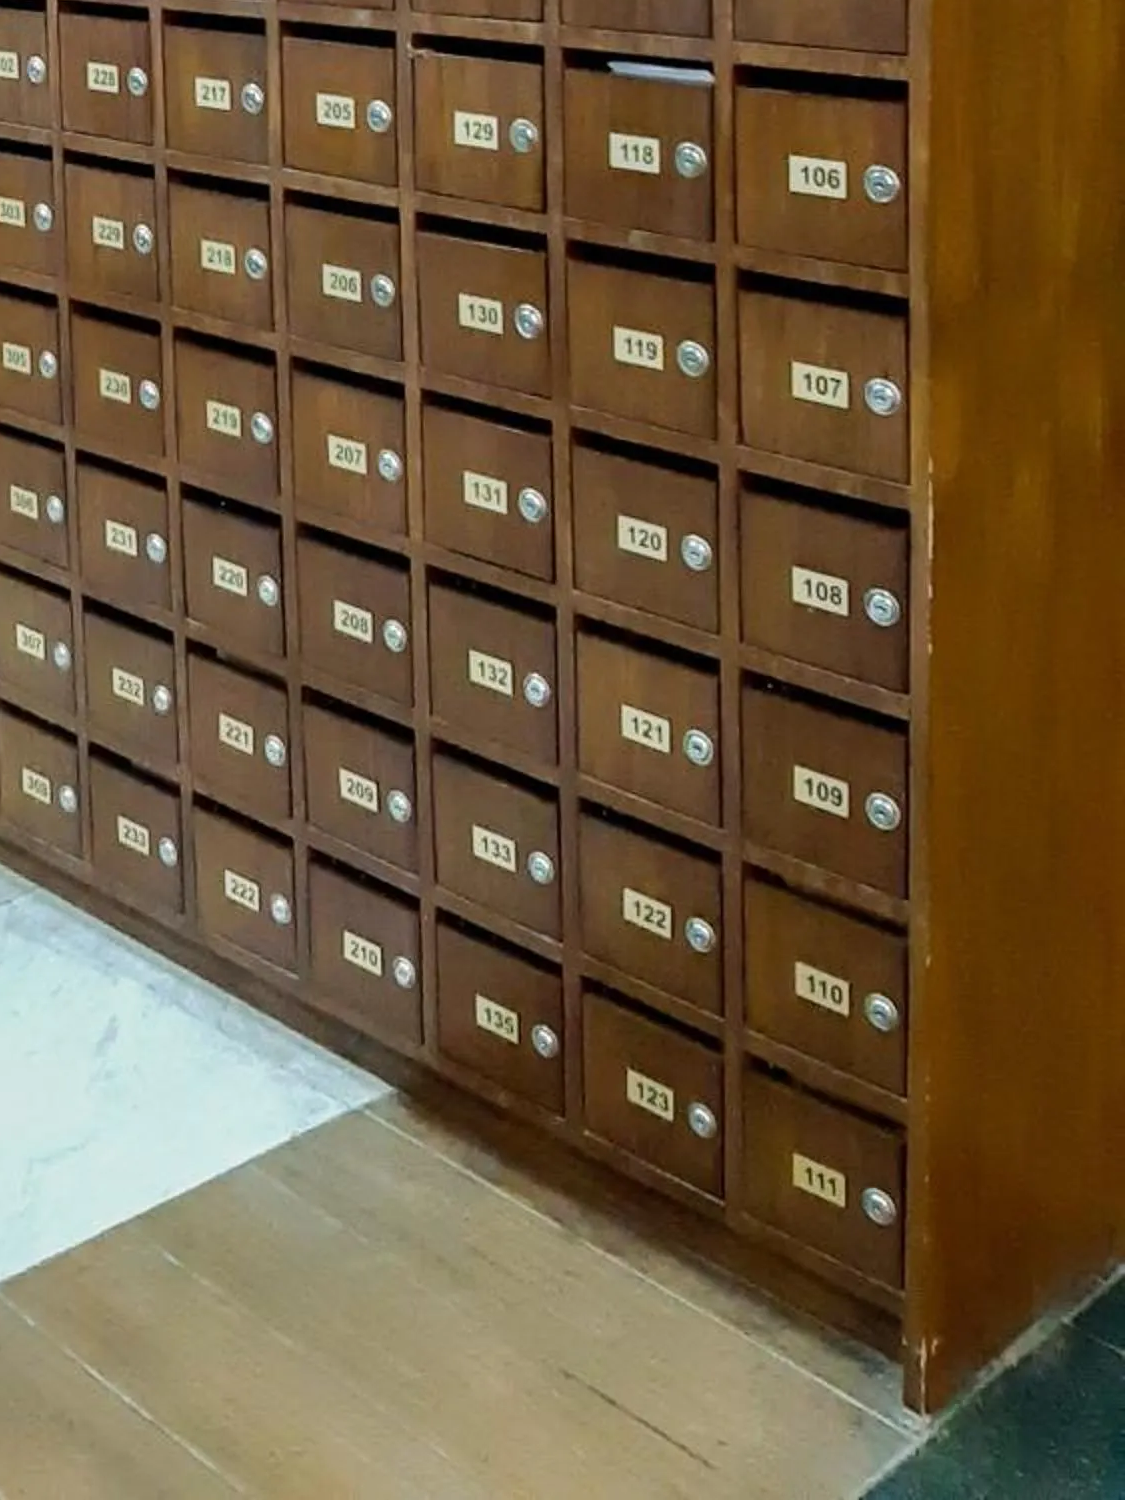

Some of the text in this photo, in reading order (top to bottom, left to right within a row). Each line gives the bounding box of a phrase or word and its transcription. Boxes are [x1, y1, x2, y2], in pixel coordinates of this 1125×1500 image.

[93, 69, 115, 88] 228
[201, 84, 228, 105] 217
[323, 100, 352, 123] 205
[463, 119, 494, 144] 129
[619, 141, 655, 167] 118
[800, 164, 841, 192] 106
[2, 203, 22, 222] 303
[98, 223, 120, 243] 229
[207, 247, 233, 269] 218
[329, 272, 358, 297] 206
[467, 302, 499, 328] 130
[624, 336, 659, 364] 119
[105, 376, 128, 398] 230
[803, 371, 843, 402] 107
[212, 407, 238, 432] 219
[335, 443, 364, 469] 207
[472, 480, 503, 508] 131
[111, 527, 133, 550] 231
[627, 524, 663, 555] 120
[219, 564, 244, 591] 220
[803, 576, 843, 609] 108
[340, 608, 369, 637] 208
[118, 675, 141, 699] 232
[477, 659, 509, 689] 132
[225, 721, 250, 749] 221
[631, 714, 664, 746] 121
[346, 776, 374, 806] 209
[804, 776, 844, 810] 109
[123, 823, 146, 849] 233
[481, 835, 512, 866] 133
[231, 878, 256, 906] 222
[632, 897, 667, 932] 122
[350, 939, 378, 970] 210
[805, 972, 844, 1009] 110
[484, 1004, 515, 1037] 135
[636, 1079, 670, 1115] 123
[803, 1164, 840, 1200] 111
